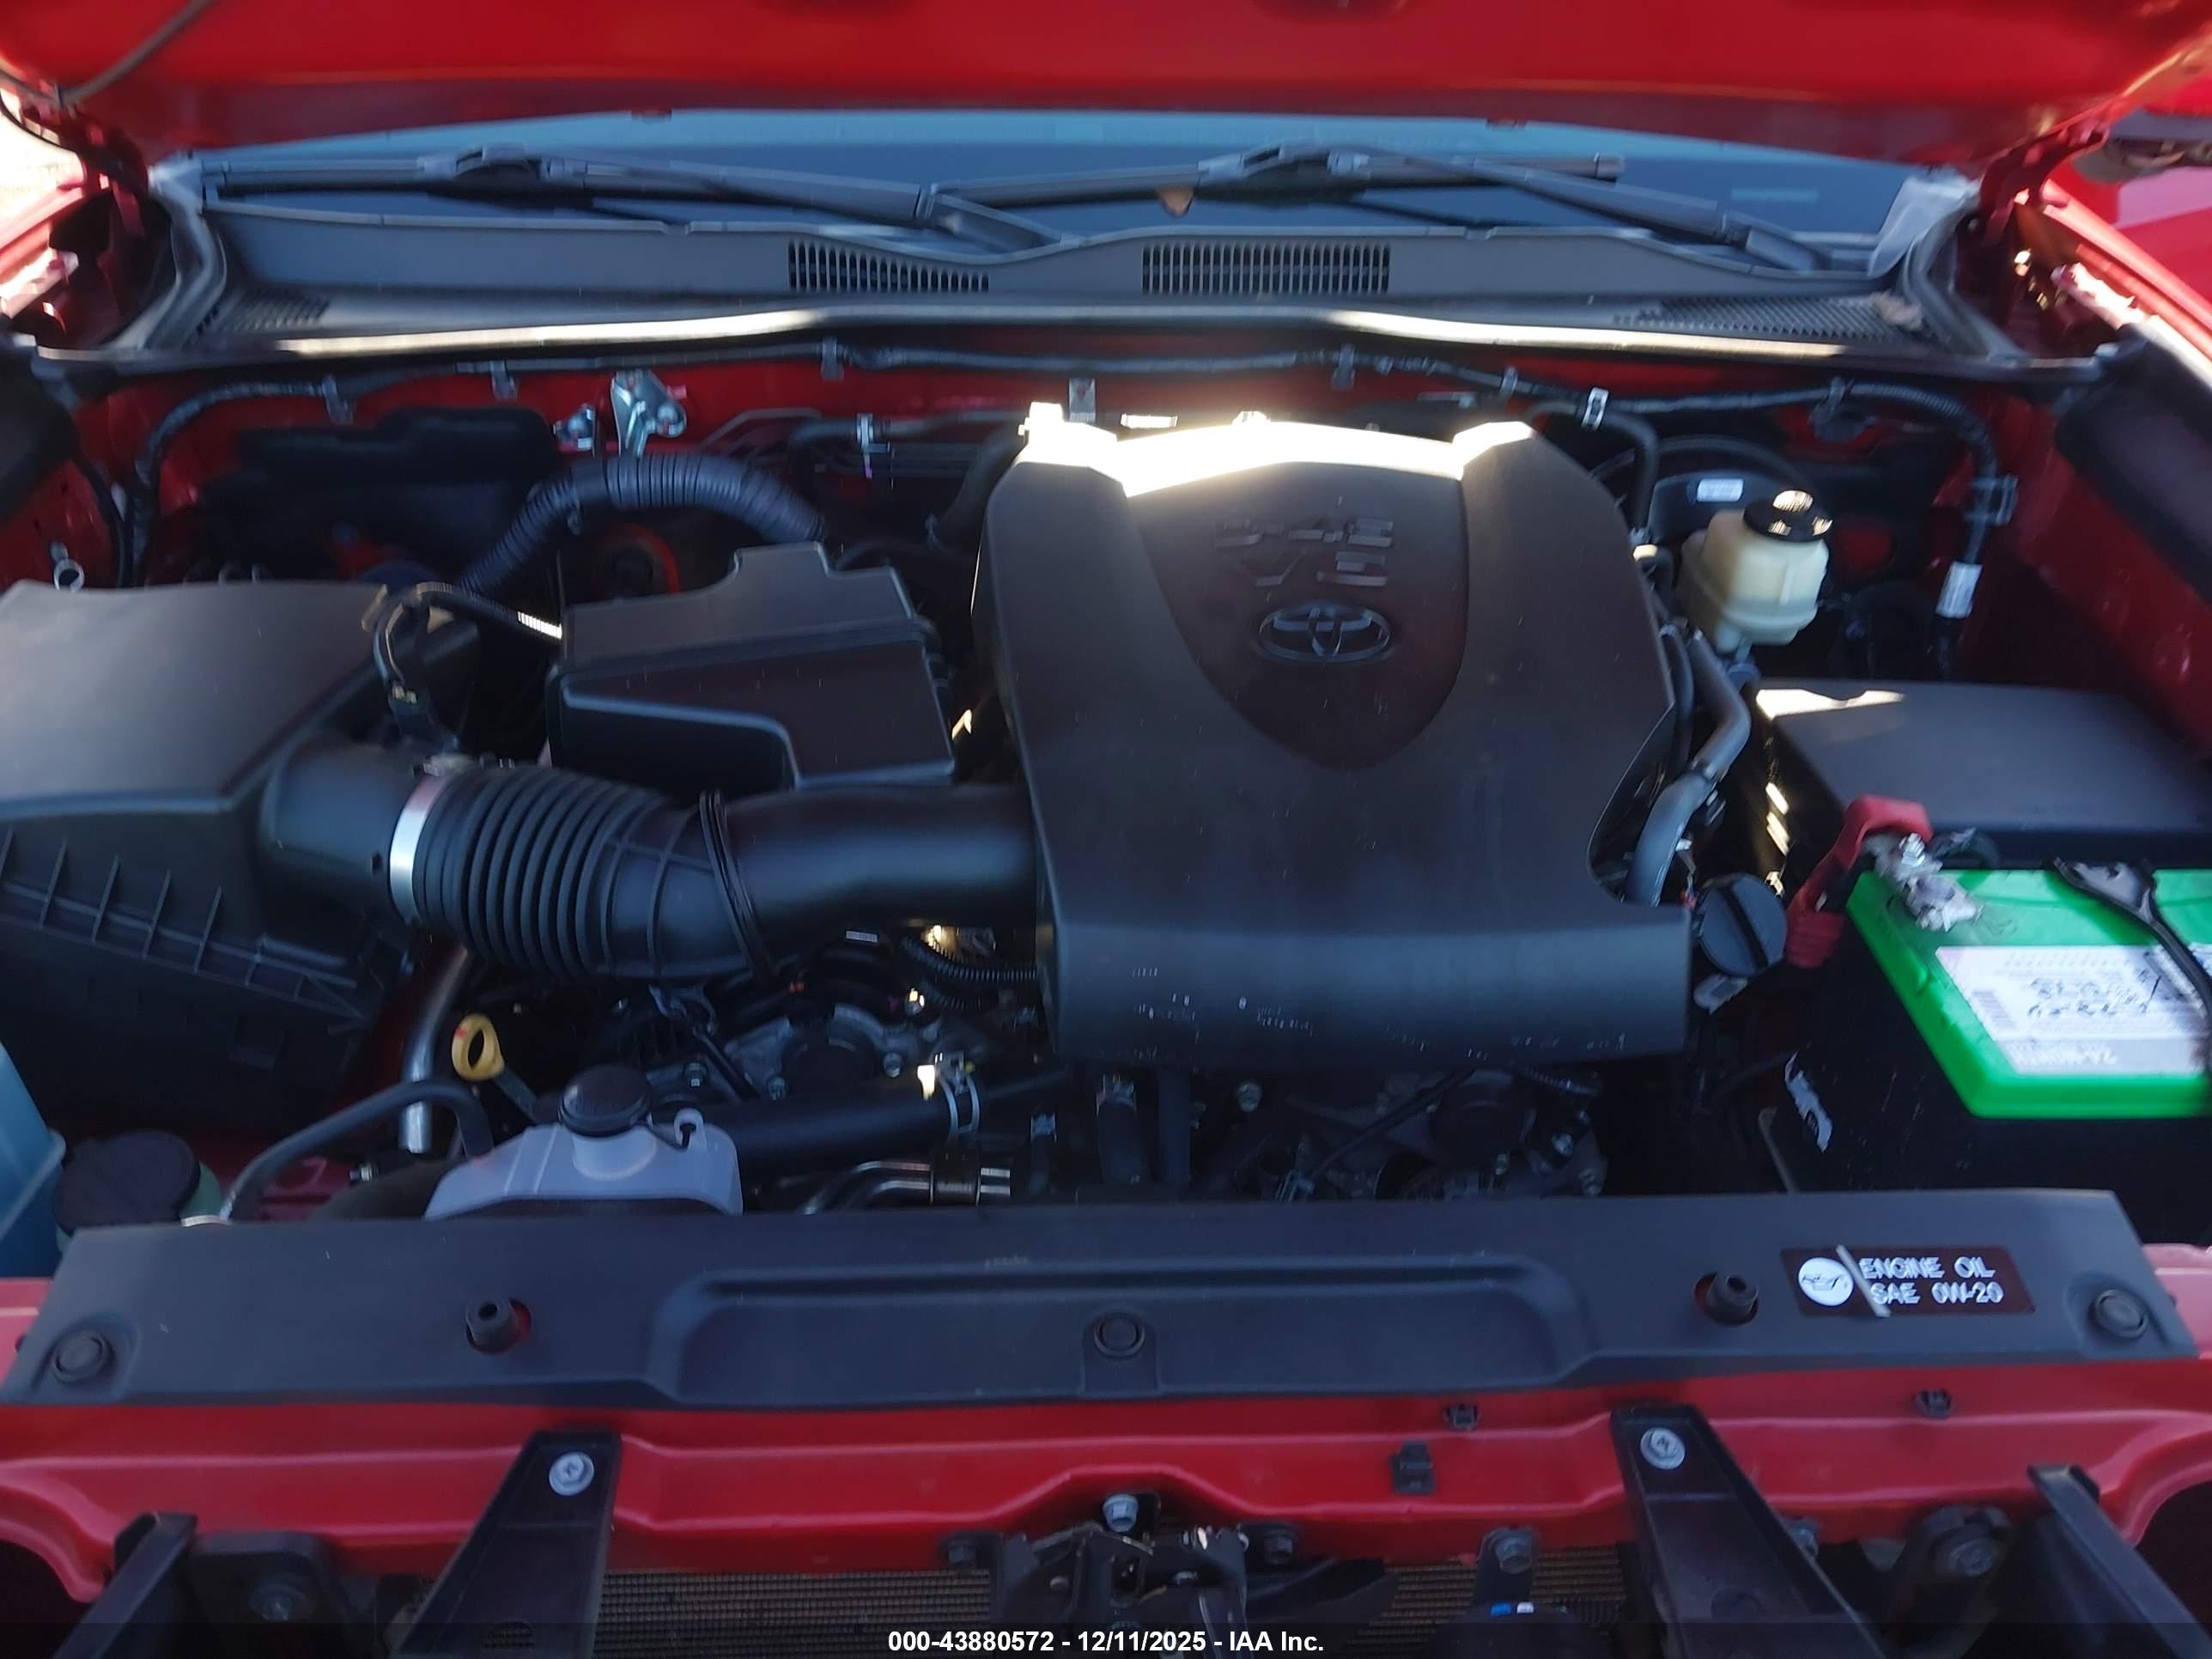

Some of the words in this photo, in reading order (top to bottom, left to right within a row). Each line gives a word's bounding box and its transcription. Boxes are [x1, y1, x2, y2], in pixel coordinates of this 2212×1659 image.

[1858, 1256, 1945, 1279] ENGINE
[1954, 1256, 1996, 1279] OIL
[1869, 1281, 1921, 1304] SAE
